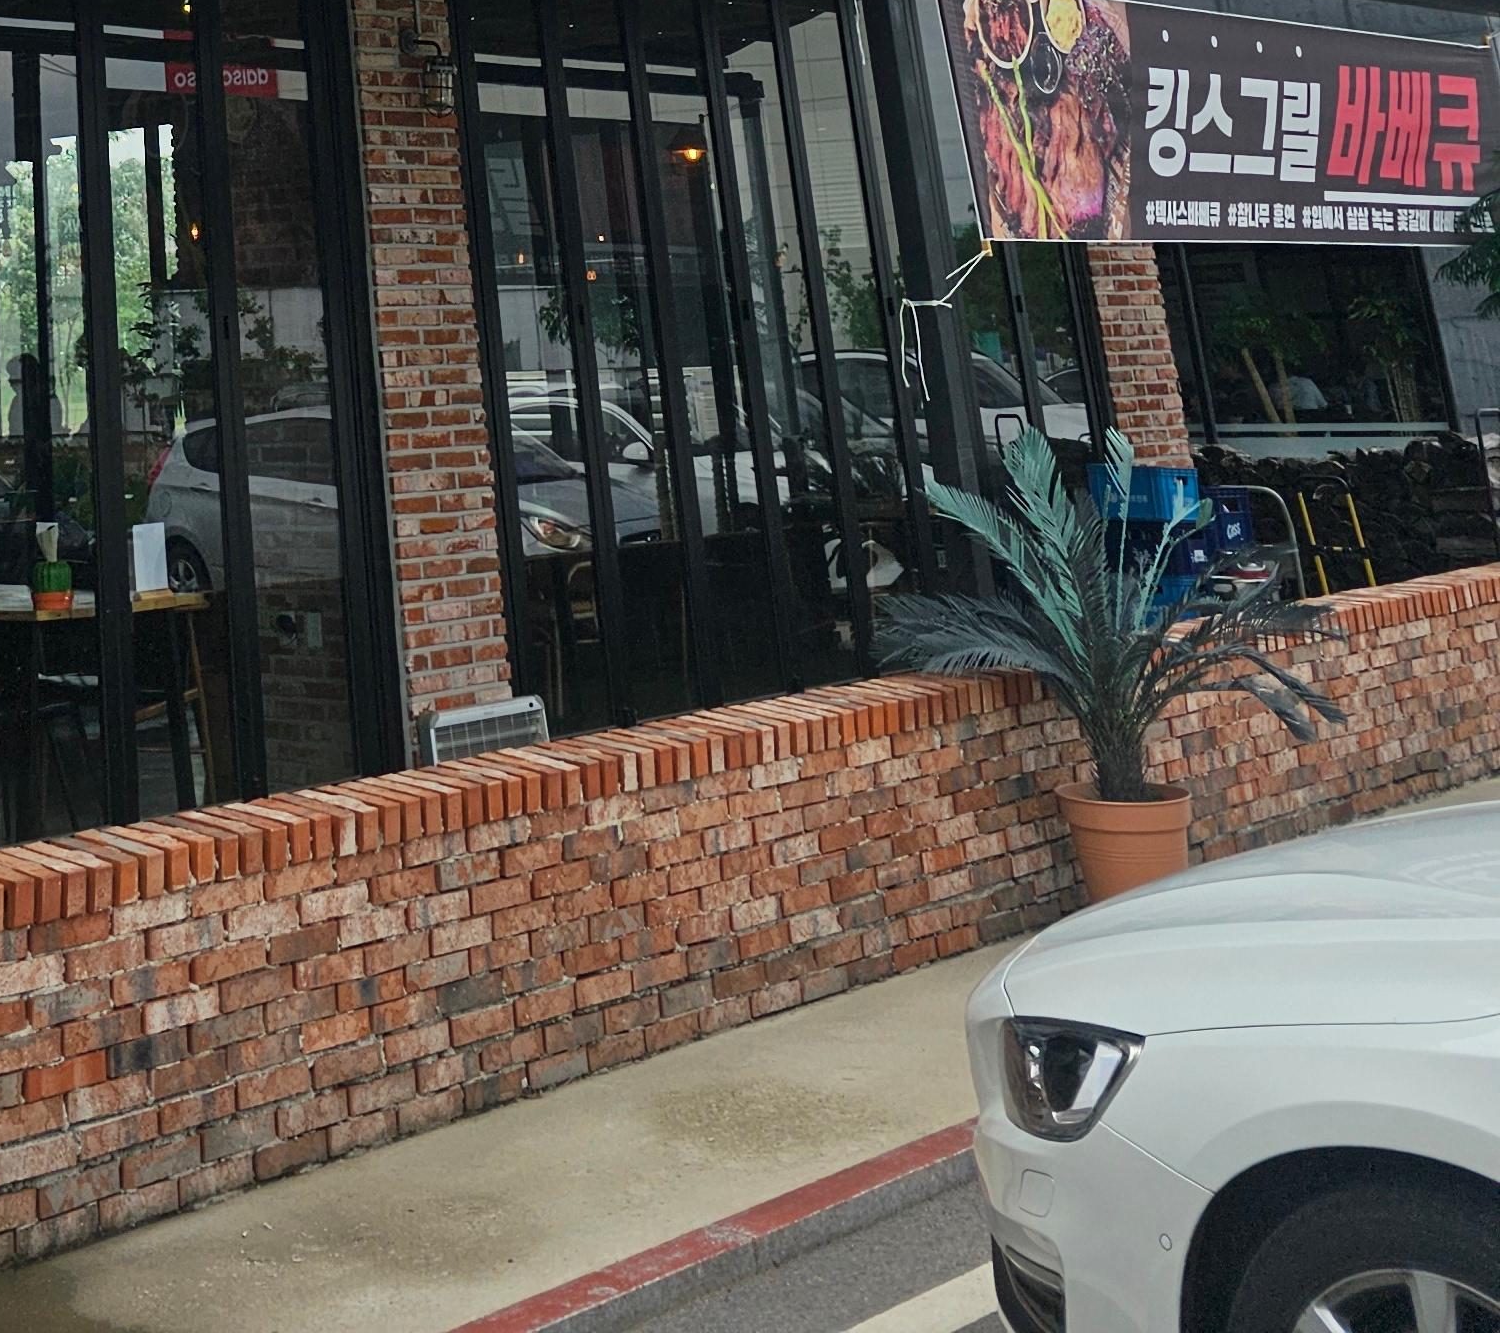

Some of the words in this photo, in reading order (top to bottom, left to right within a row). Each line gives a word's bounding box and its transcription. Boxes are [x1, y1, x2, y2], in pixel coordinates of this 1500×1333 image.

[1144, 67, 1321, 183] 킹스그릴
[1326, 65, 1481, 191] 바베큐
[1227, 202, 1270, 229] #참나무
